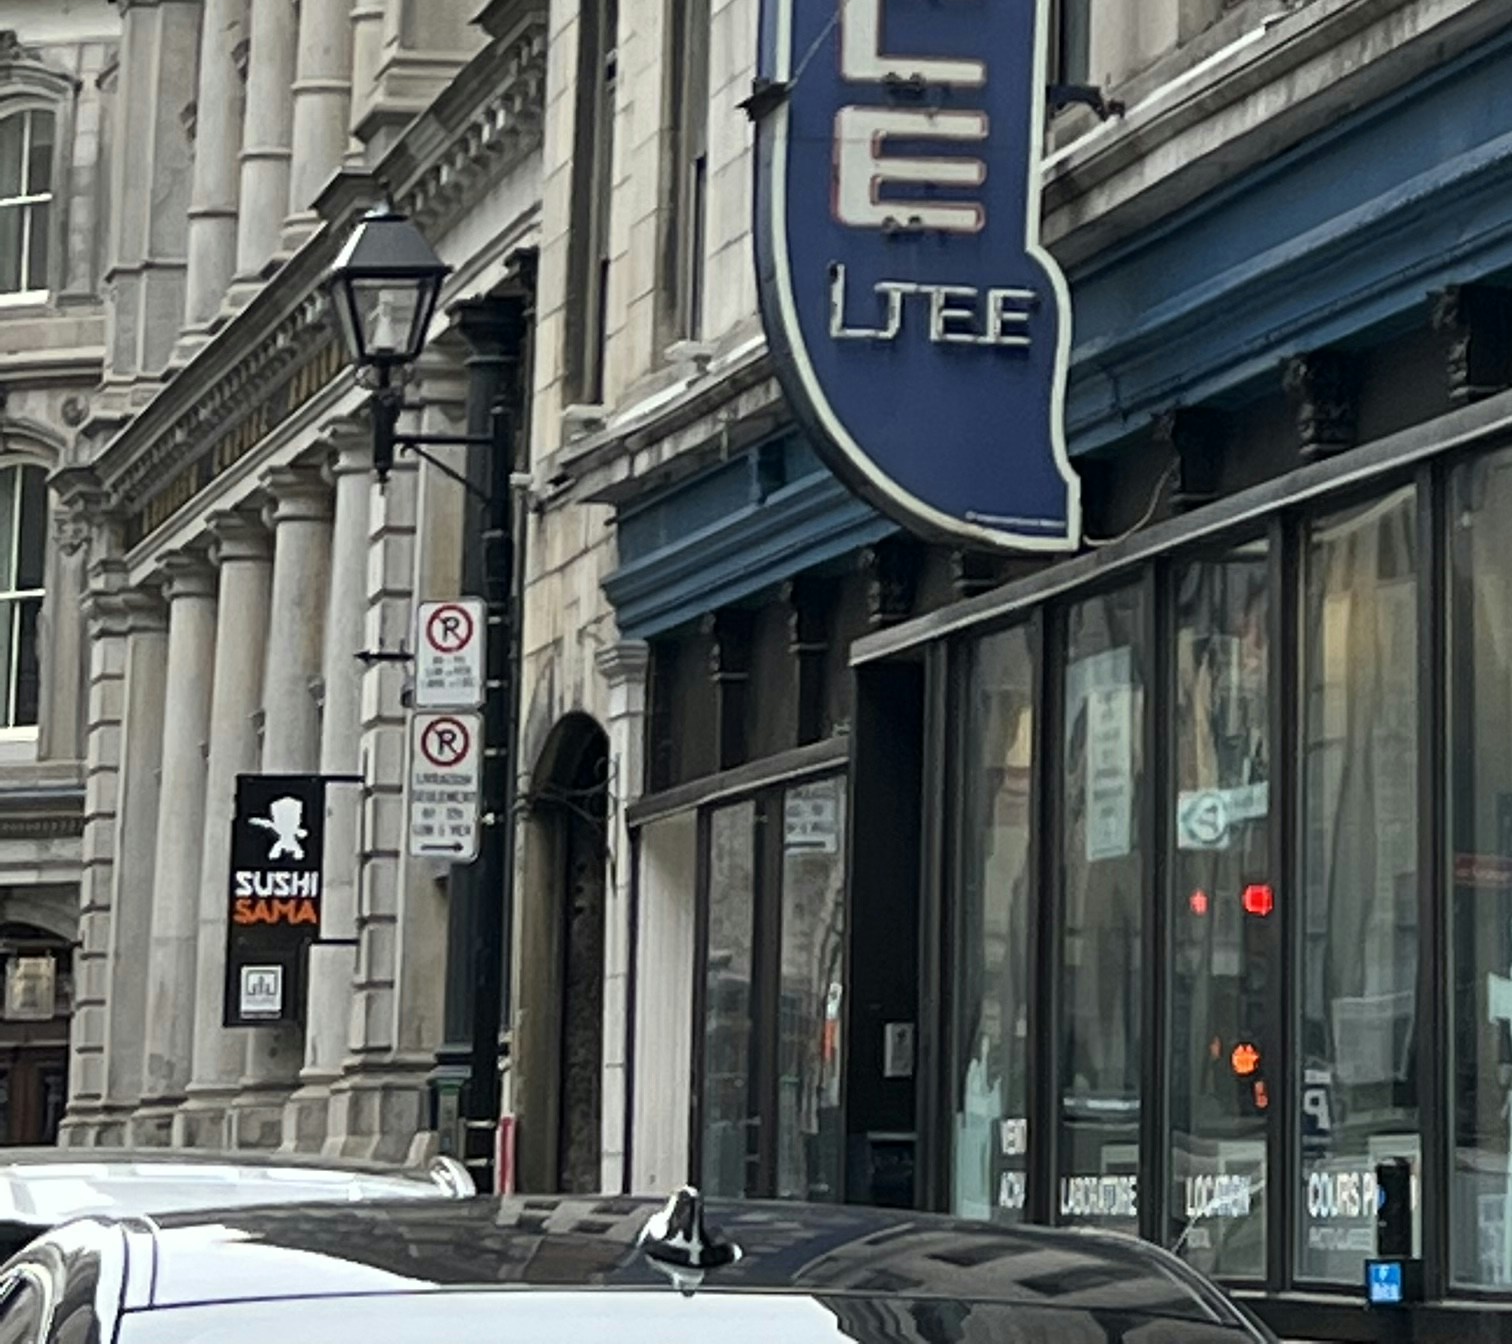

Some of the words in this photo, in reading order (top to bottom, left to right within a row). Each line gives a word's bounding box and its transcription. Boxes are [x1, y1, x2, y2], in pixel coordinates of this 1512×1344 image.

[235, 871, 319, 897] SUSHI
[233, 898, 317, 924] SAMA
[1307, 1172, 1360, 1218] COURS
